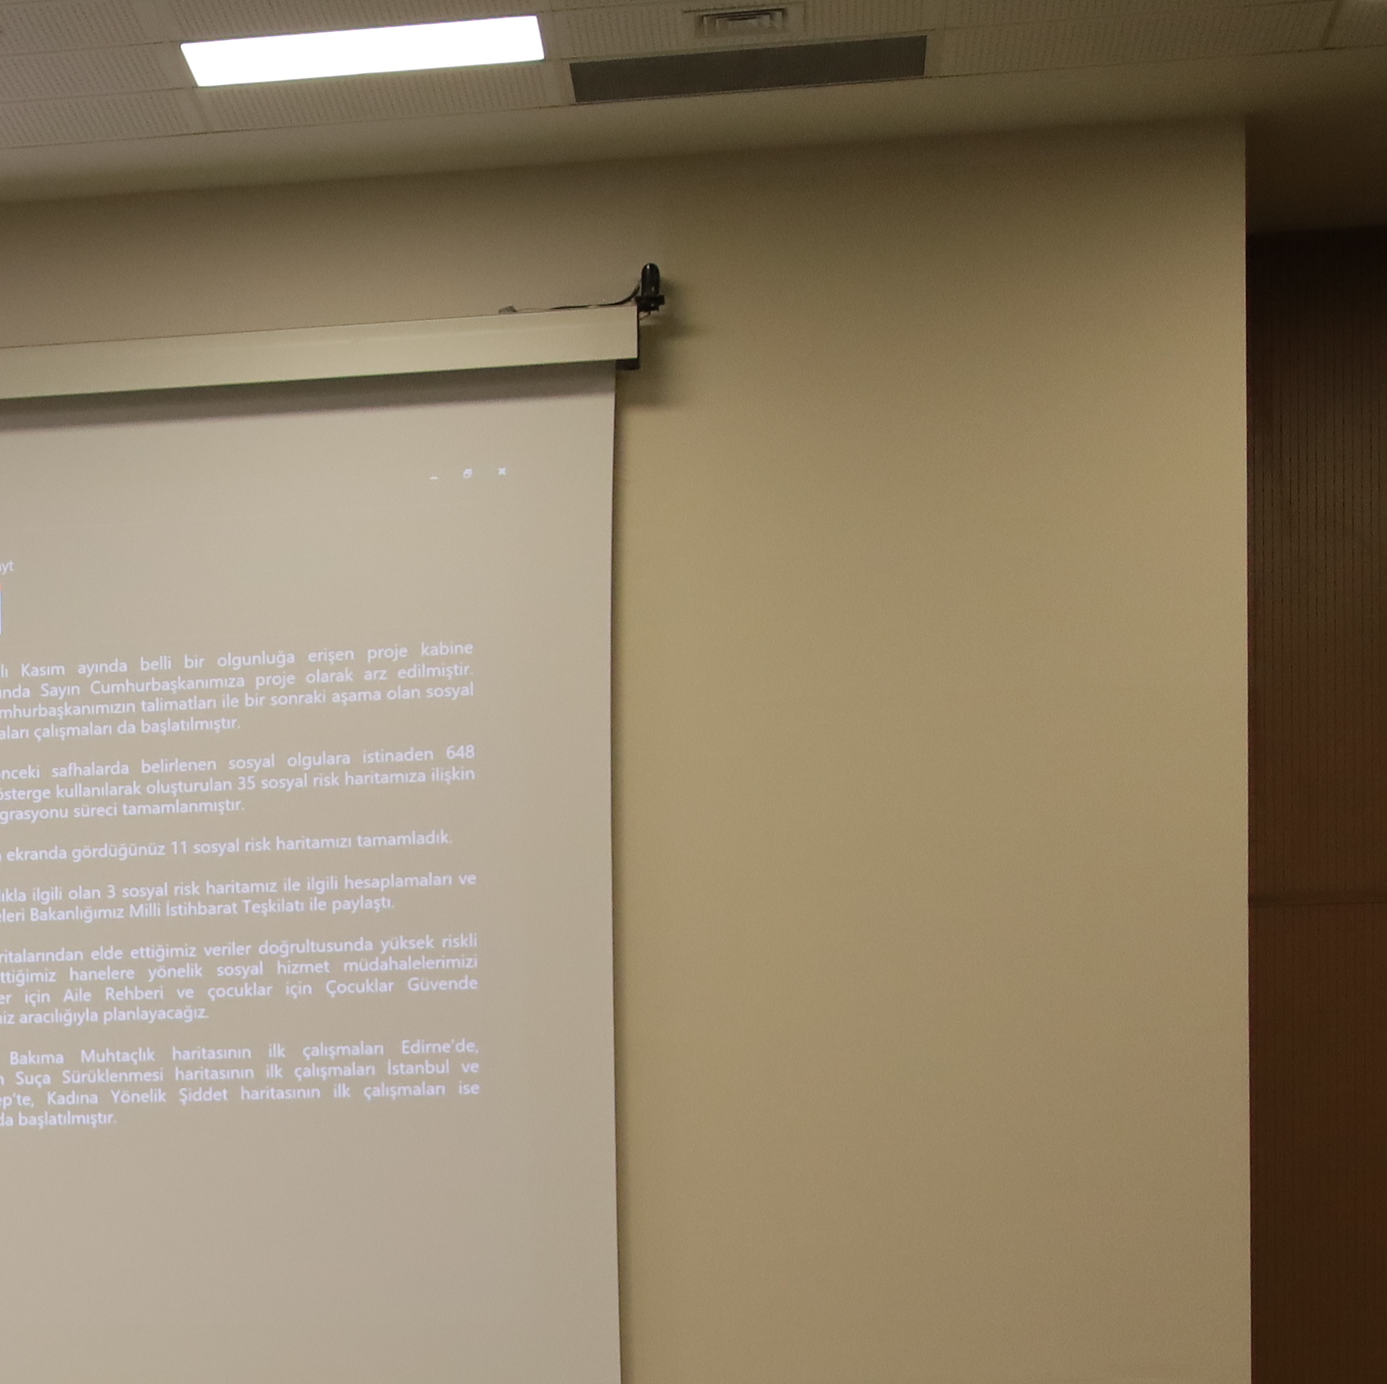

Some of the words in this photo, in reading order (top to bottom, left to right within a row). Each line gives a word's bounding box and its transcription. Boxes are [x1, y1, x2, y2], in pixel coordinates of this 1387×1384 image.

[21, 663, 65, 676] Kasım
[77, 658, 128, 677] ayında
[140, 655, 172, 671] belli
[184, 654, 205, 668] bir
[216, 650, 295, 670] olgunluğa
[307, 649, 355, 664] erişen
[367, 647, 408, 662] proje
[421, 641, 474, 656] kabine
[40, 682, 81, 700] Sayın
[255, 674, 296, 689] proje
[305, 667, 354, 683] olarak
[363, 669, 387, 680] arz
[397, 663, 473, 679] edilmiştir.
[140, 695, 217, 712] talimatları
[222, 693, 240, 707] ile
[244, 692, 266, 706] bir
[270, 689, 326, 705] sonraki
[331, 690, 382, 705] aşama
[386, 685, 421, 700] olan
[426, 680, 474, 700] sosyal
[33, 721, 112, 741] çalışmaları
[117, 719, 136, 733] da
[51, 760, 130, 777] safhalarda
[141, 758, 217, 773] belirlenen
[228, 753, 275, 771] sosyal
[286, 751, 351, 770] olgulara
[362, 747, 434, 763] istinaden
[446, 744, 475, 759] 648
[146, 777, 233, 796] oluşturulan
[237, 775, 256, 790] 35
[260, 772, 308, 791] sosyal
[313, 771, 340, 786] risk
[344, 770, 426, 785] haritamıza
[431, 766, 476, 784] ilişkin
[73, 804, 118, 817] süreci
[6, 845, 67, 861] ekranda
[71, 843, 166, 862] gördüğünüz
[171, 840, 187, 854] 11
[193, 837, 240, 856] sosyal
[244, 836, 271, 851] risk
[276, 835, 352, 850] haritamızı
[356, 829, 453, 847] tamamladık.
[10, 1050, 65, 1065] Bakıma
[80, 1047, 156, 1064] Muhtaçlık
[172, 1046, 252, 1060] haritasının
[268, 1043, 286, 1057] ilk
[302, 1040, 384, 1060] çalışmaları
[401, 1038, 479, 1054] Edirne'de,
[15, 1070, 51, 1088] Suça
[175, 1066, 255, 1080] haritasının
[266, 1063, 283, 1077] ilk
[294, 1061, 376, 1081] çalışmaları
[387, 1058, 450, 1075] İstanbul
[461, 1062, 480, 1072] ve
[47, 1090, 99, 1104] Kadına
[110, 1087, 167, 1103] Yönelik
[179, 1086, 228, 1105] Şiddet
[240, 1085, 321, 1099] haritasının
[333, 1083, 351, 1097] ilk
[363, 1081, 446, 1100] çalışmaları
[458, 1083, 480, 1094] ise
